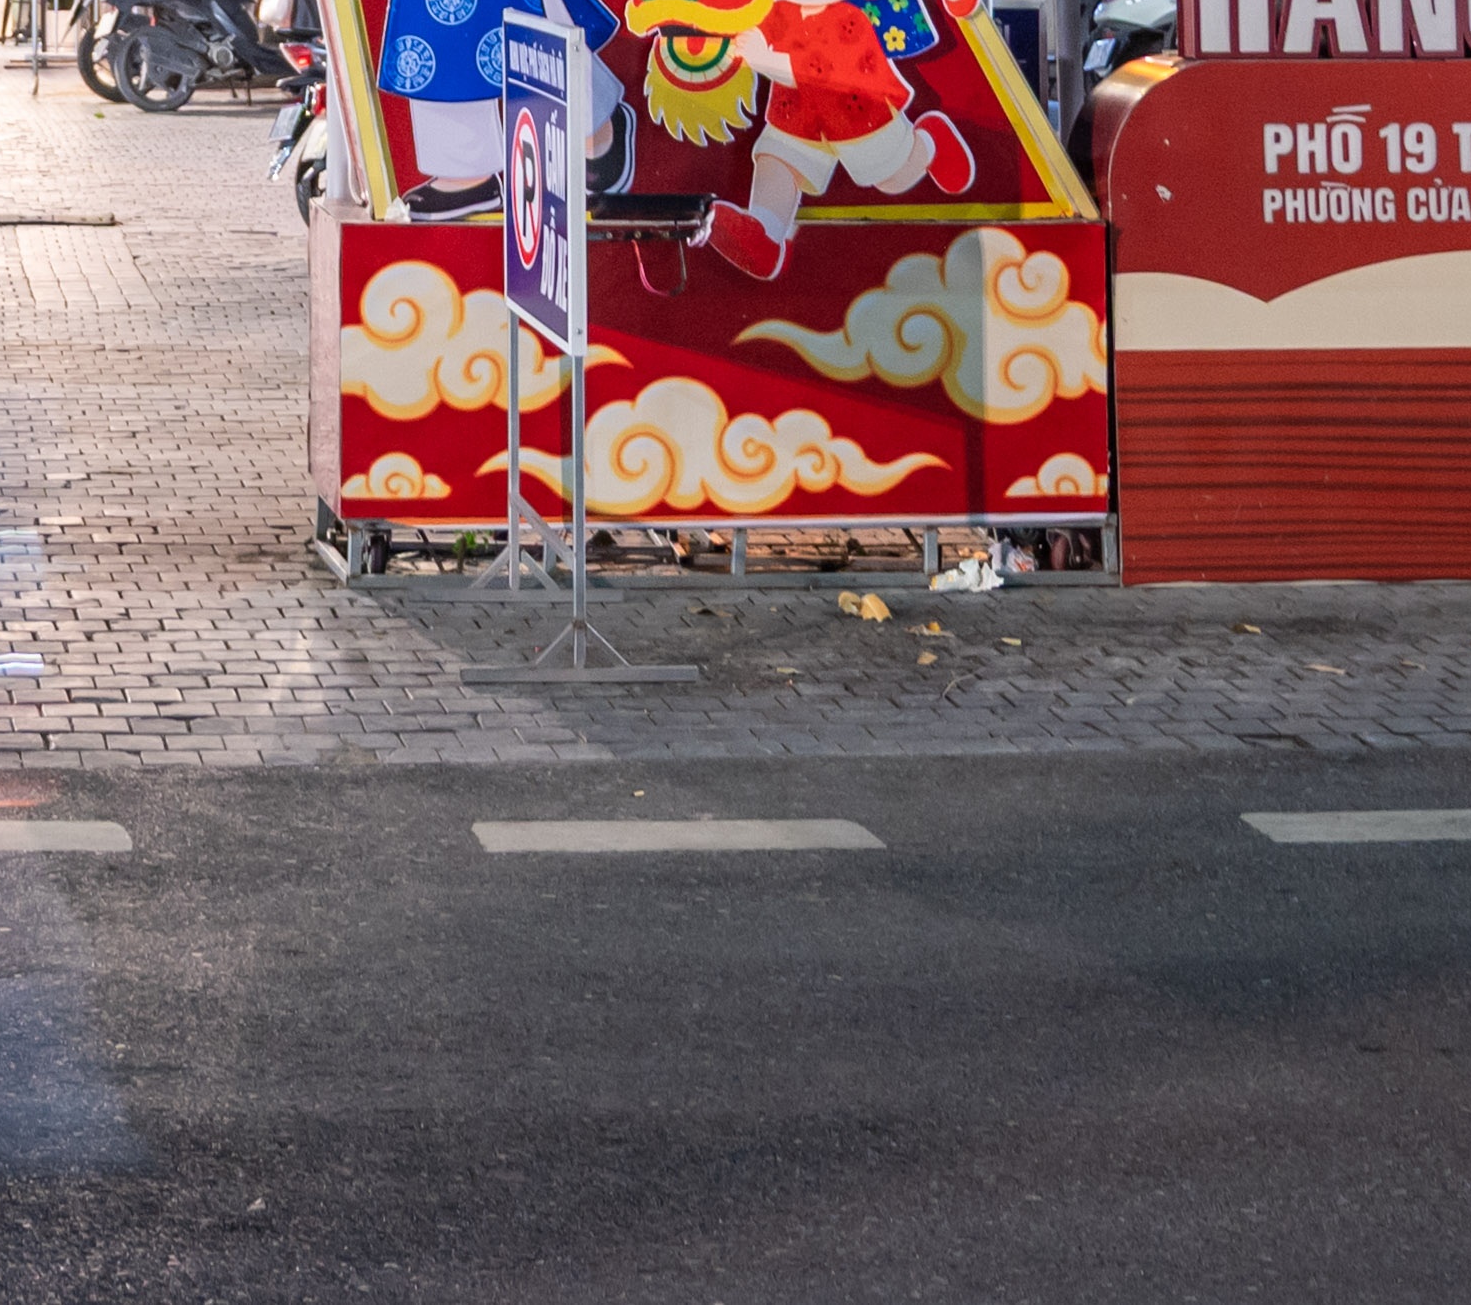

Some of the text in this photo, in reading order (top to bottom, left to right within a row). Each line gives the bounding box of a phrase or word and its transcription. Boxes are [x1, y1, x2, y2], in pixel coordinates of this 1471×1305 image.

[544, 110, 566, 201] CẤM
[1263, 104, 1372, 174] PHỐ
[1379, 123, 1437, 174] 19
[1263, 180, 1396, 224] PHƯỜNG
